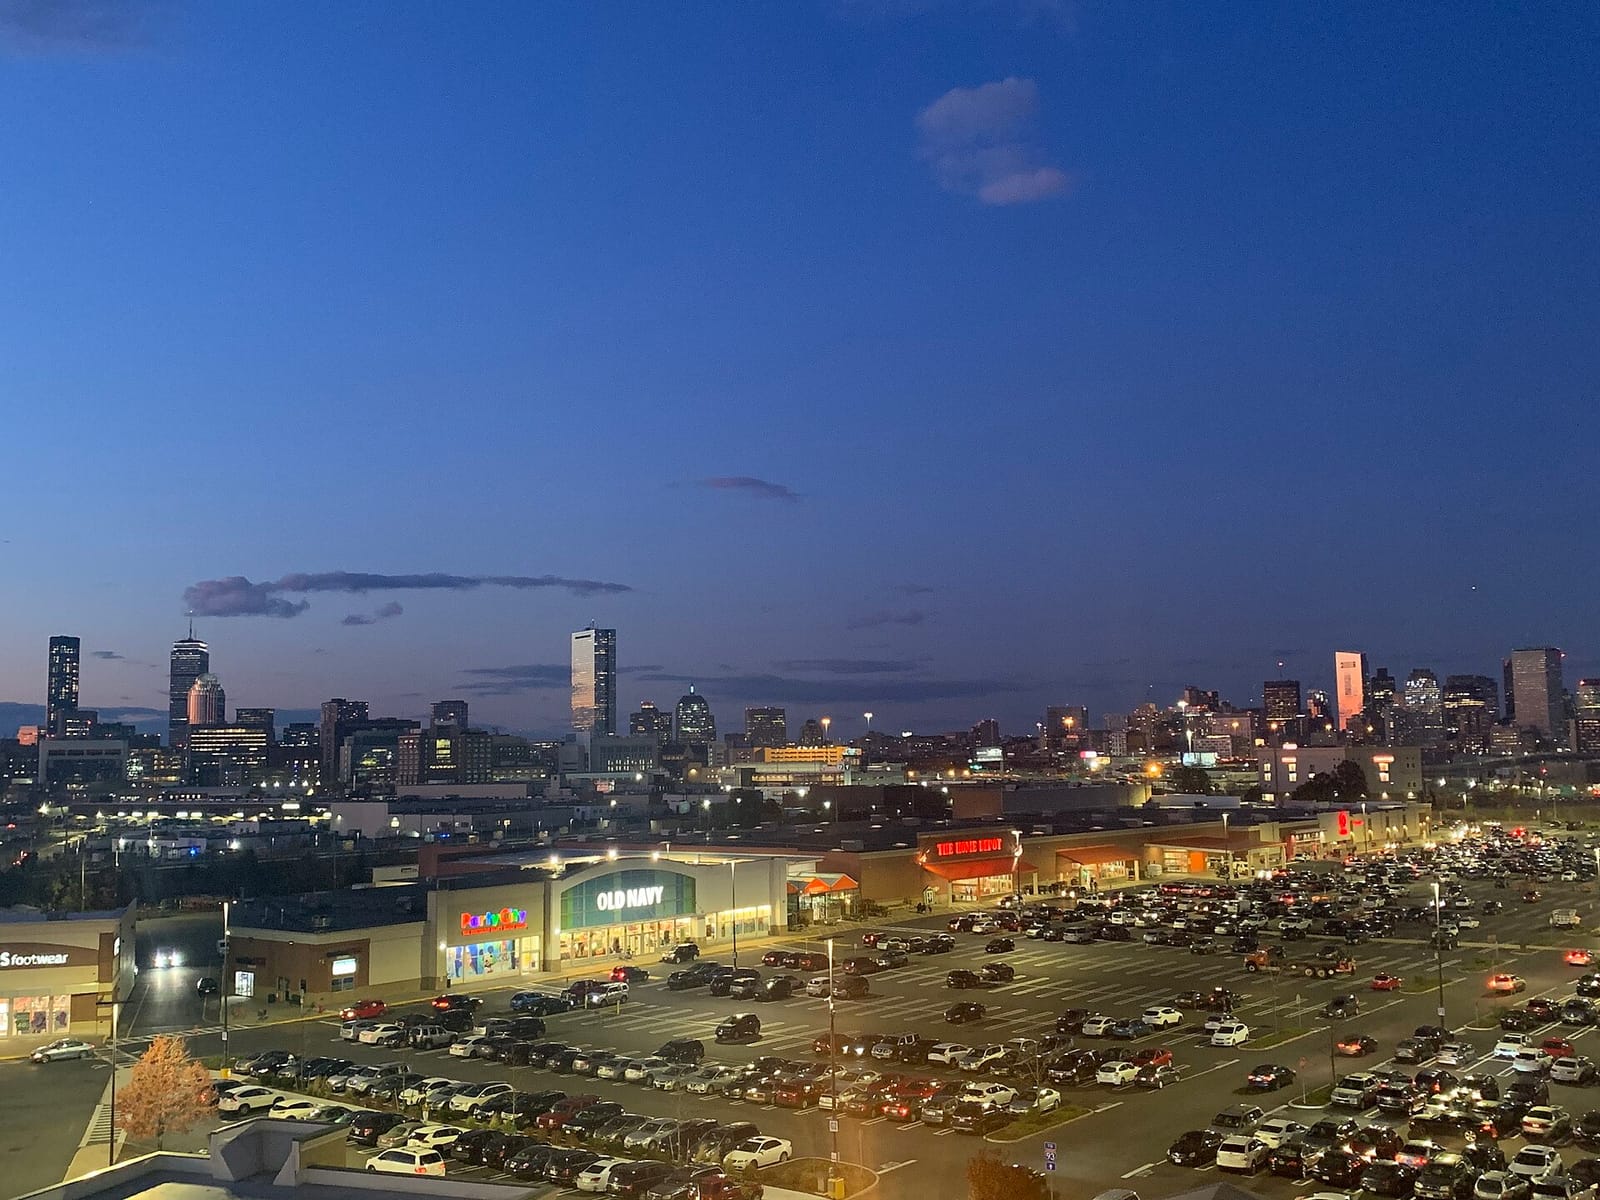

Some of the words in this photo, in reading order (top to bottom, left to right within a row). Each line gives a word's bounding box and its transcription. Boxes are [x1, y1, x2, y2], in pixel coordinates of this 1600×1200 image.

[936, 842, 954, 856] THE
[596, 892, 626, 911] OLD
[626, 886, 664, 908] NAVY
[461, 911, 500, 929] Party
[500, 907, 527, 925] City
[10, 953, 68, 966] footwear
